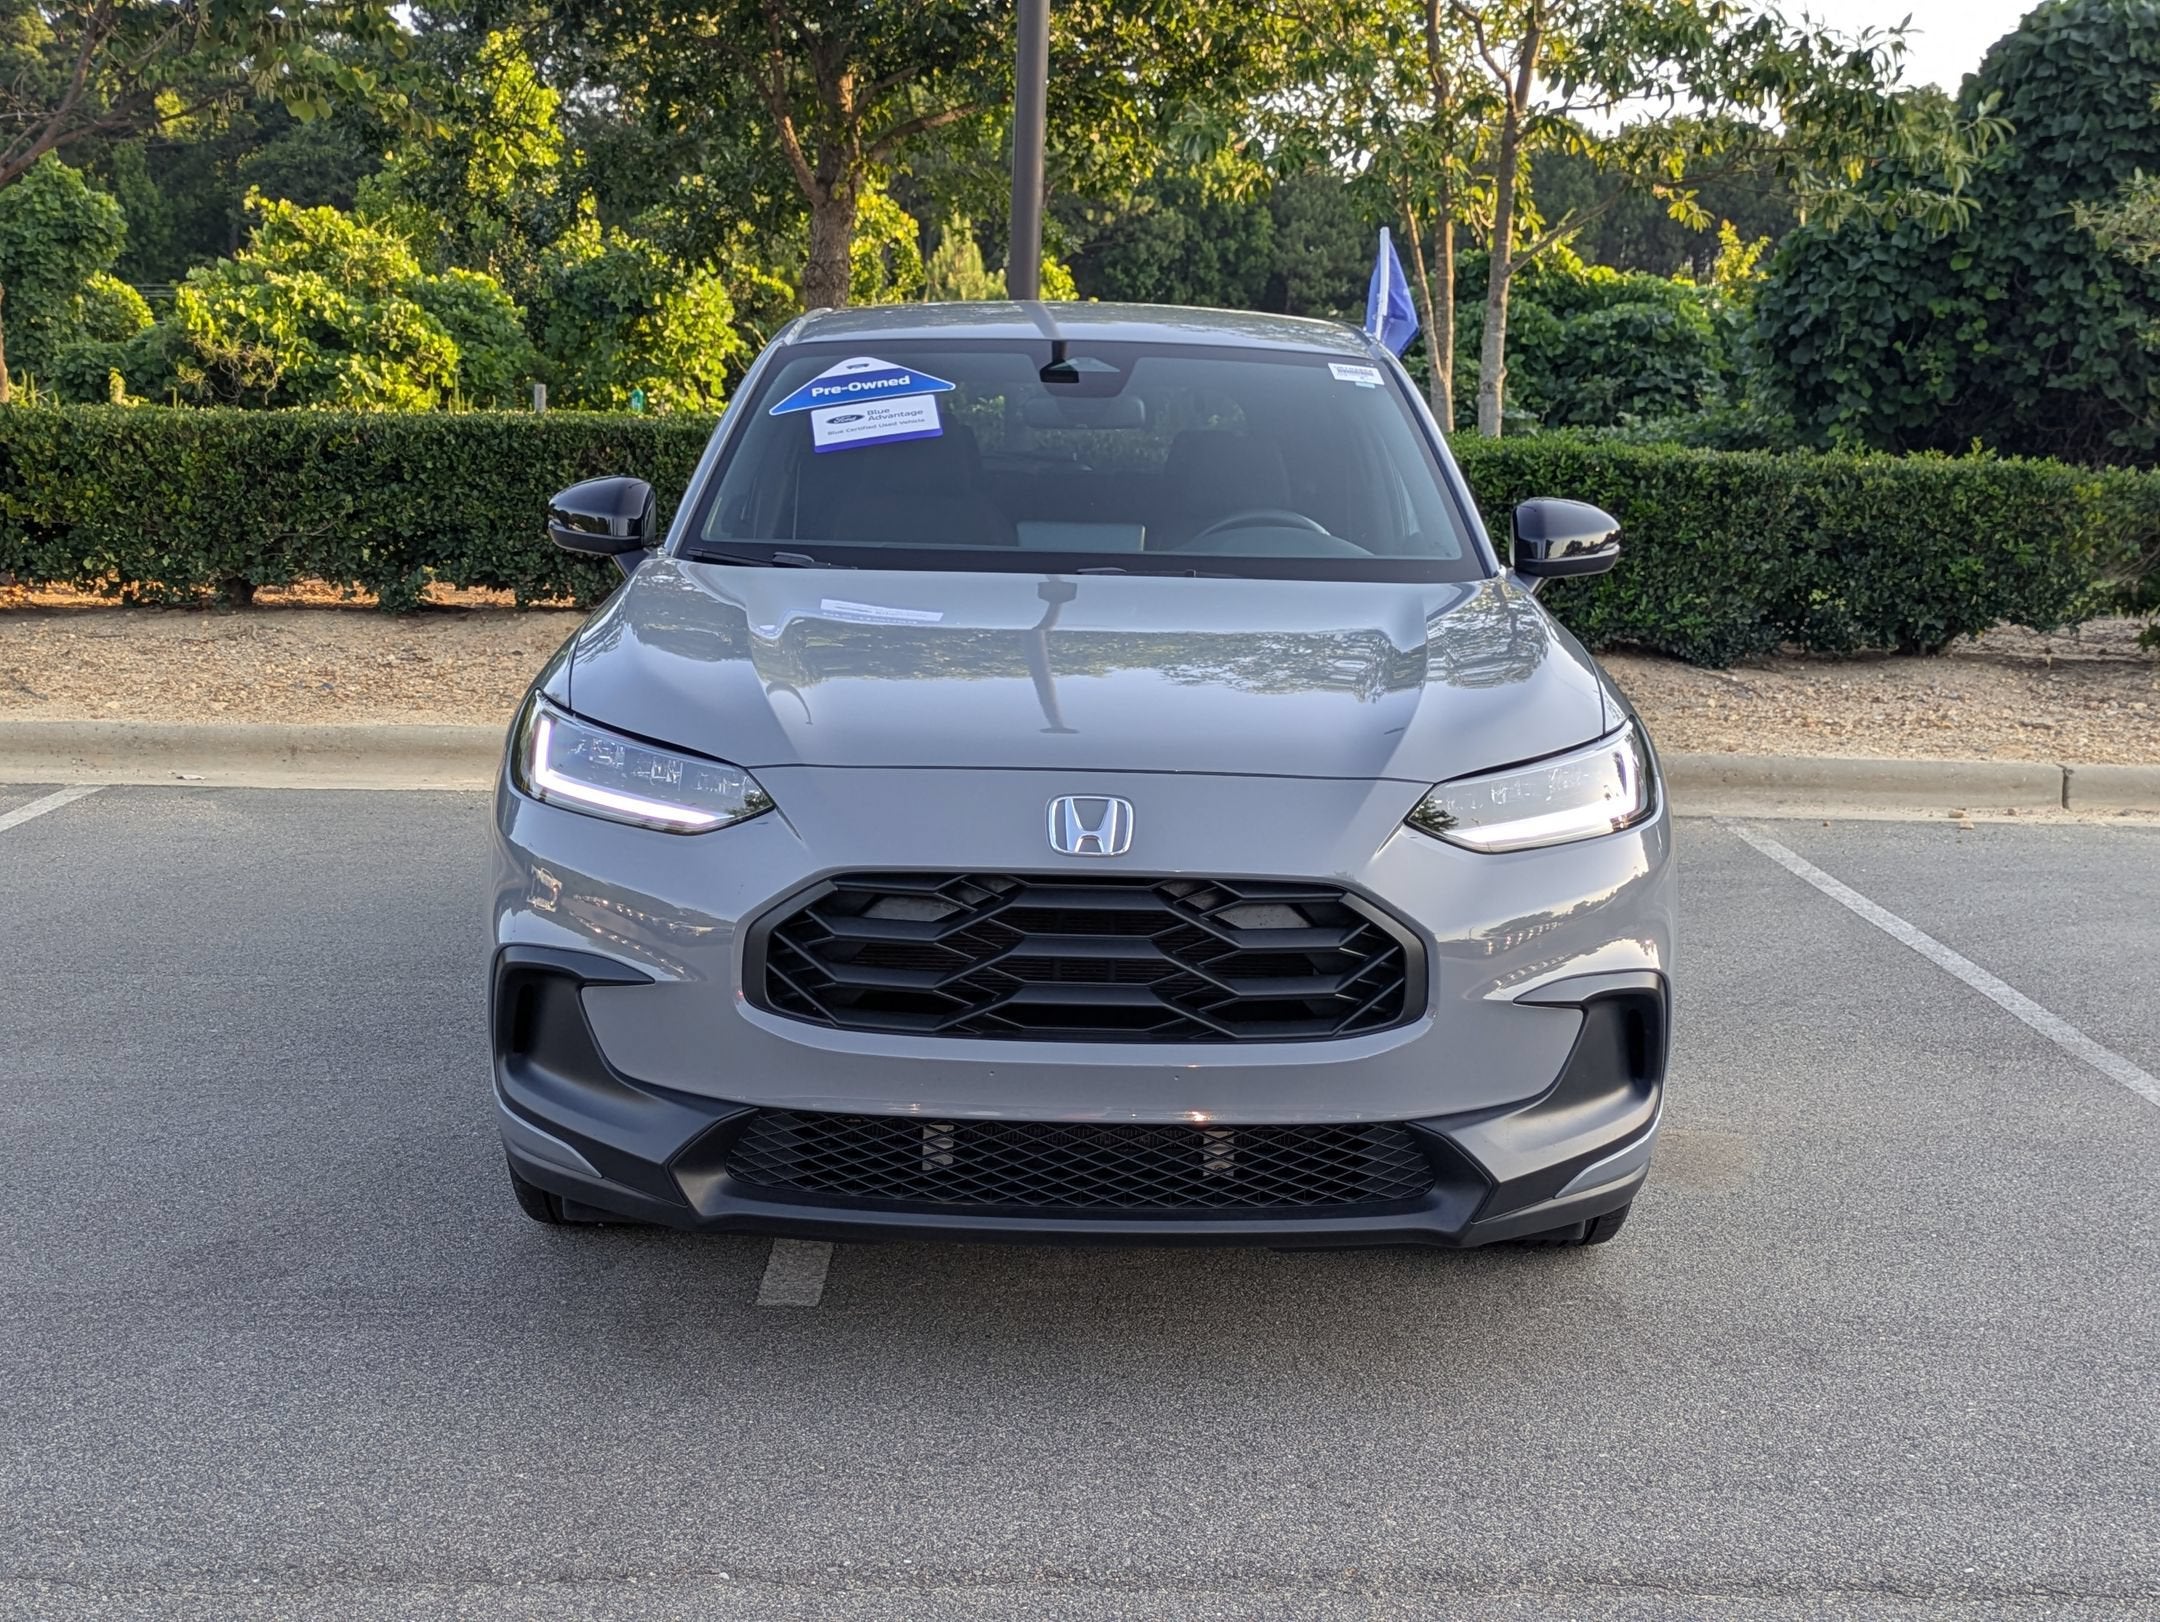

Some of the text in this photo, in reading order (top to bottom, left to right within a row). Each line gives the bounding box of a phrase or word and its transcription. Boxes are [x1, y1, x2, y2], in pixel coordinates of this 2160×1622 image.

[811, 375, 911, 397] Pre-Owned
[867, 408, 890, 416] Blue
[868, 409, 924, 422] Advantage
[845, 424, 877, 433] Certified
[878, 421, 898, 429] Used
